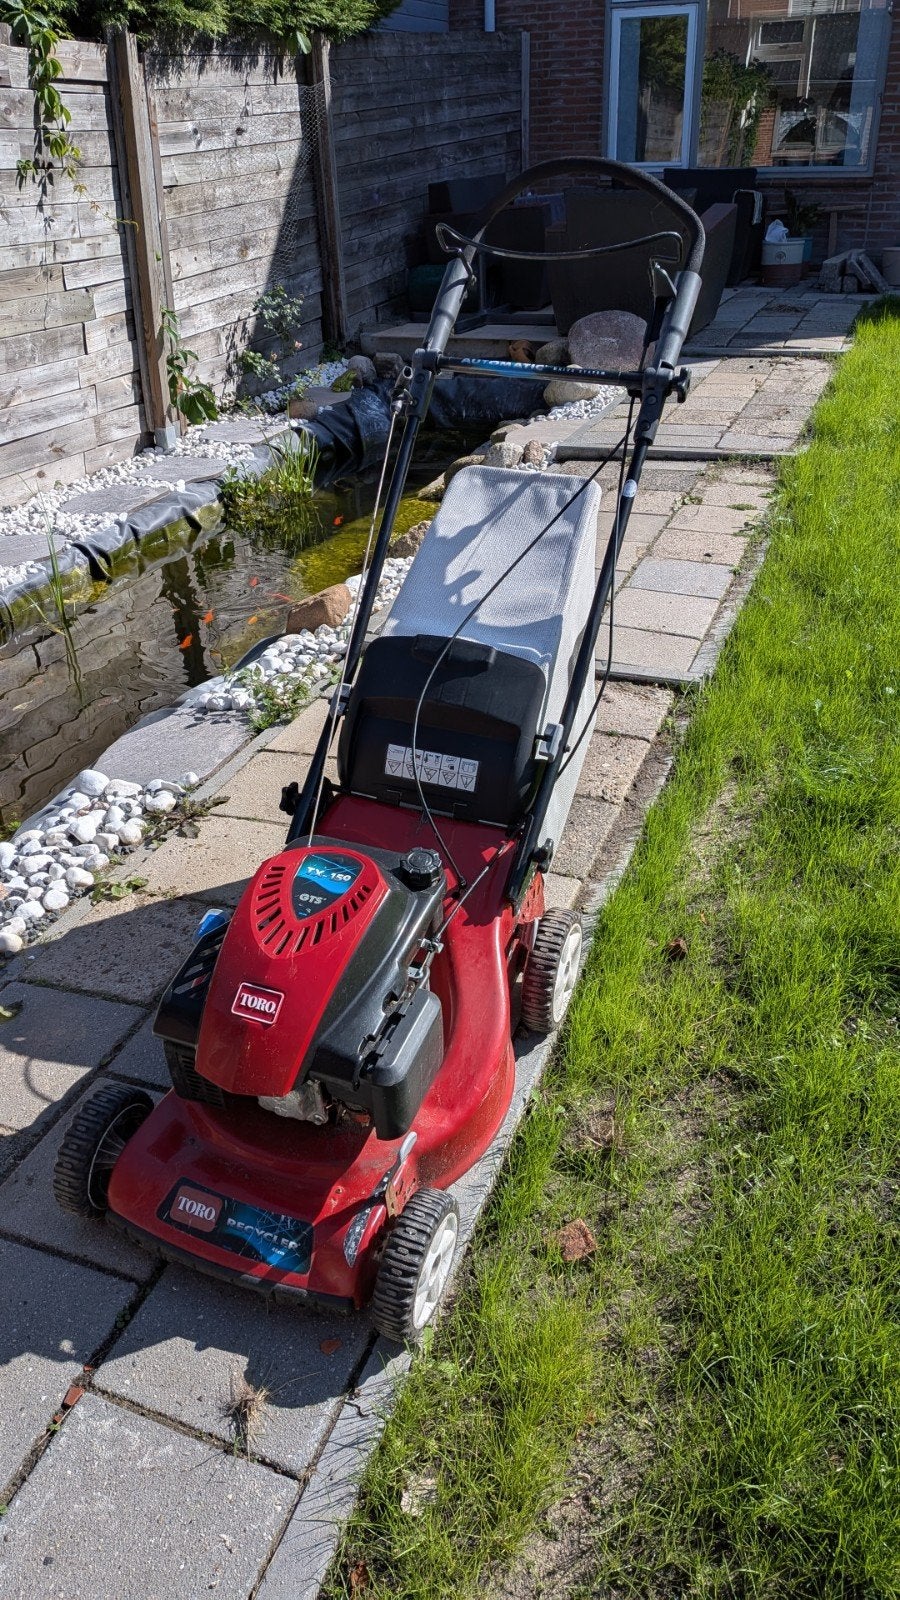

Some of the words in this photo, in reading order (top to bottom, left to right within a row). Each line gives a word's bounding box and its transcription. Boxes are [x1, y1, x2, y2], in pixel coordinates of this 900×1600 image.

[461, 357, 545, 371] AUTOMATIC
[299, 893, 323, 905] GTS
[240, 992, 276, 1013] TORO
[178, 1196, 215, 1222] TORO
[226, 1217, 299, 1250] RECYCLER
